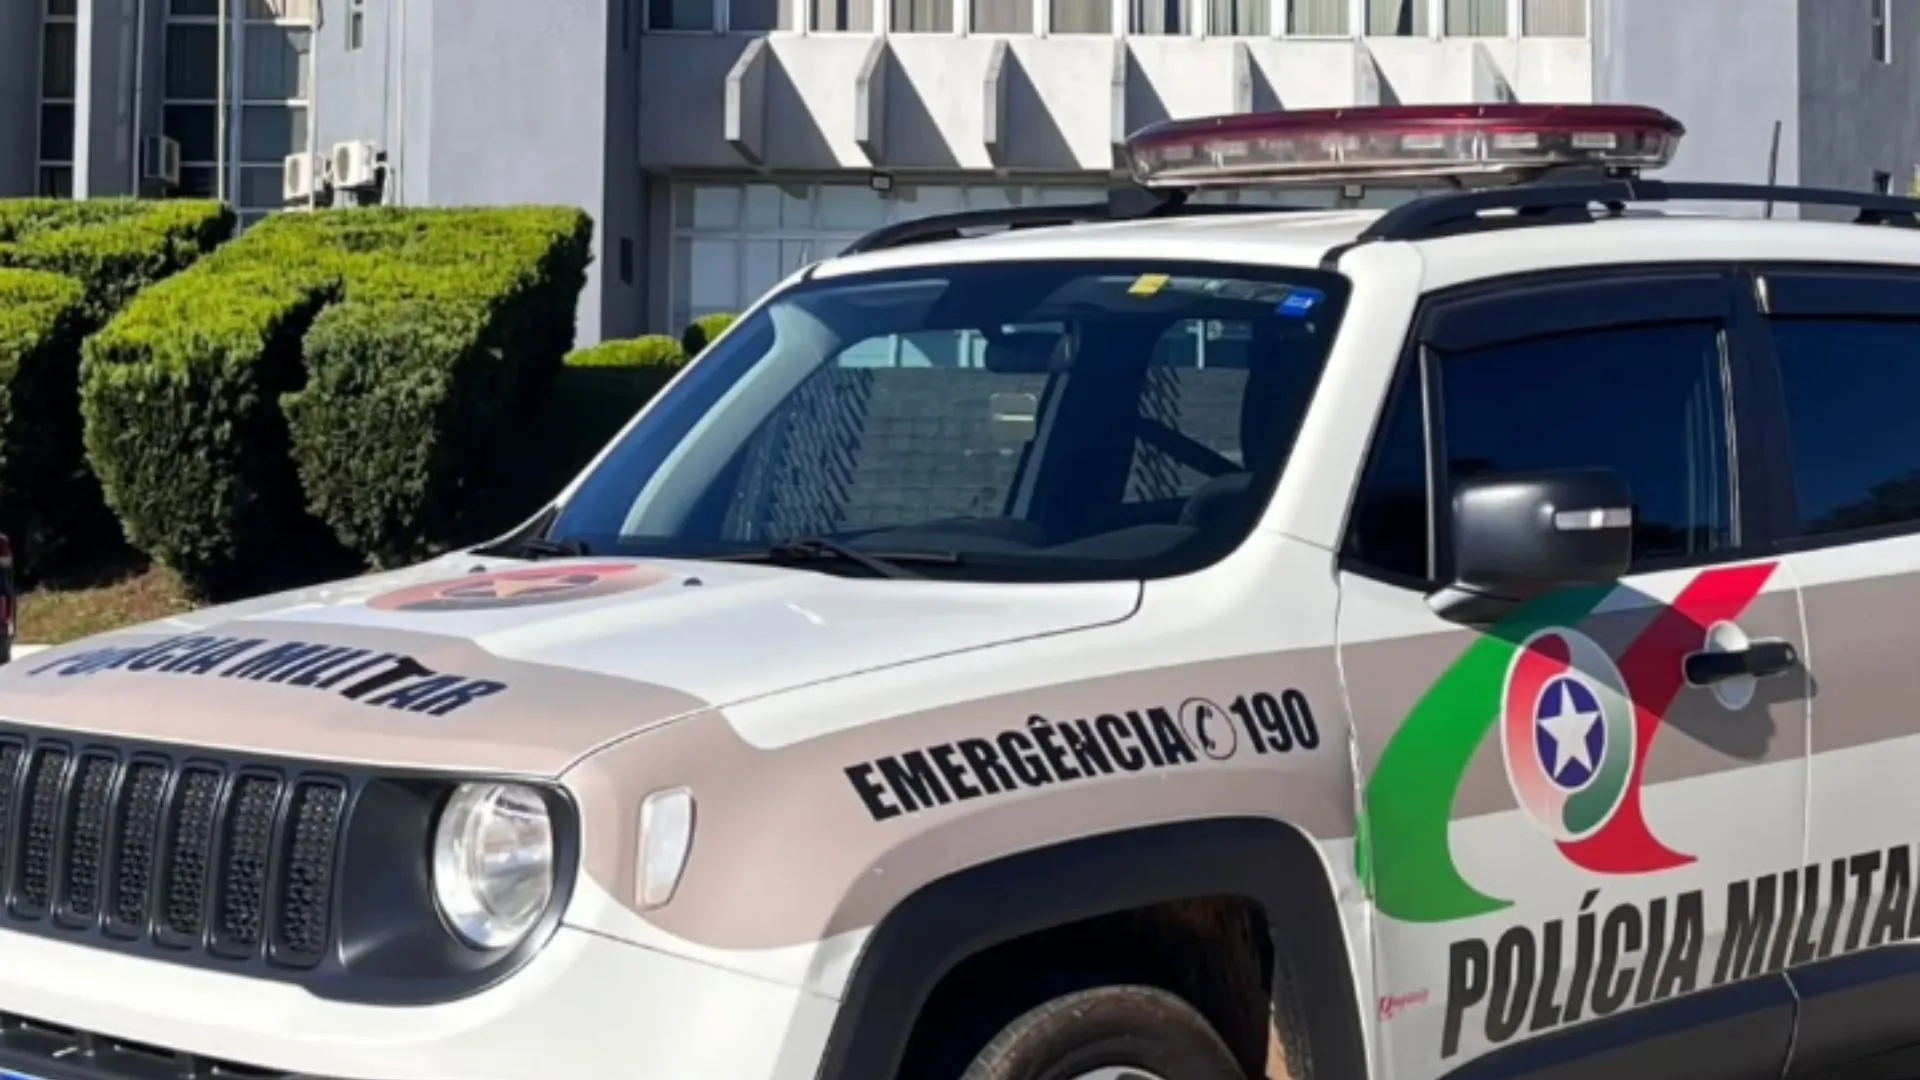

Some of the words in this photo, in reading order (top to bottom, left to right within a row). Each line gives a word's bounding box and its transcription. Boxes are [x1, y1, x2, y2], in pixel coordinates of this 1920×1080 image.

[219, 640, 508, 717] MILITAR
[843, 706, 1197, 822] EMERGÊNCIA
[1229, 689, 1320, 754] 190
[1441, 888, 1704, 1060] POLÍCIA
